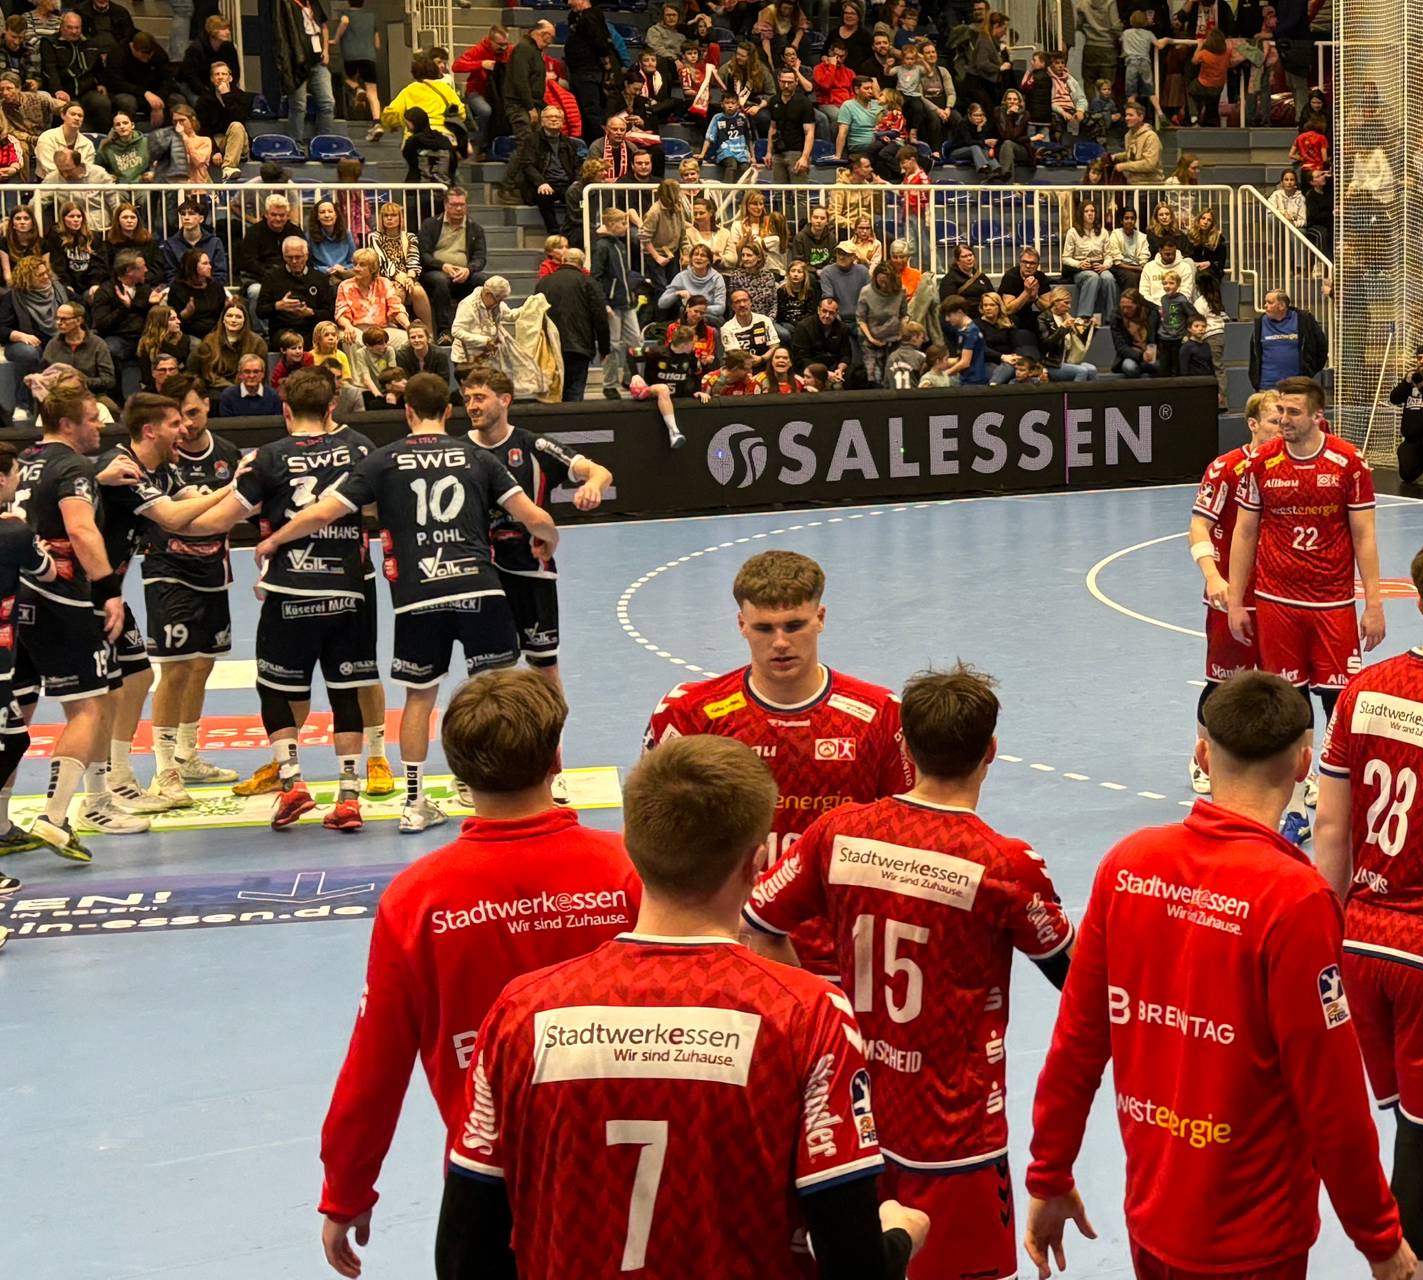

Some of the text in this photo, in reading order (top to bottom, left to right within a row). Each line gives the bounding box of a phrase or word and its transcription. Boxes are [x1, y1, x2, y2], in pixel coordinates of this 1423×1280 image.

[894, 370, 911, 390] 11
[287, 449, 351, 473] SWG
[396, 448, 466, 471] SWG
[410, 474, 466, 526] 10
[416, 529, 466, 546] P. OHL
[1292, 526, 1319, 551] 22
[418, 547, 461, 578] Volk
[163, 623, 189, 649] 19
[1363, 758, 1418, 858] 28
[838, 846, 970, 888] Stadtwerkessen
[880, 869, 965, 899] Wir sind Zuhause.
[6, 904, 368, 937] -in-essen.de
[508, 911, 629, 934] Wir sind Zuhause.
[852, 914, 930, 1025] 15
[544, 1021, 740, 1051] Stadtwerkessen
[613, 1048, 736, 1068] Wir sind Zuhause.
[861, 1037, 923, 1075] MSCHEID
[605, 1119, 669, 1272] 7
